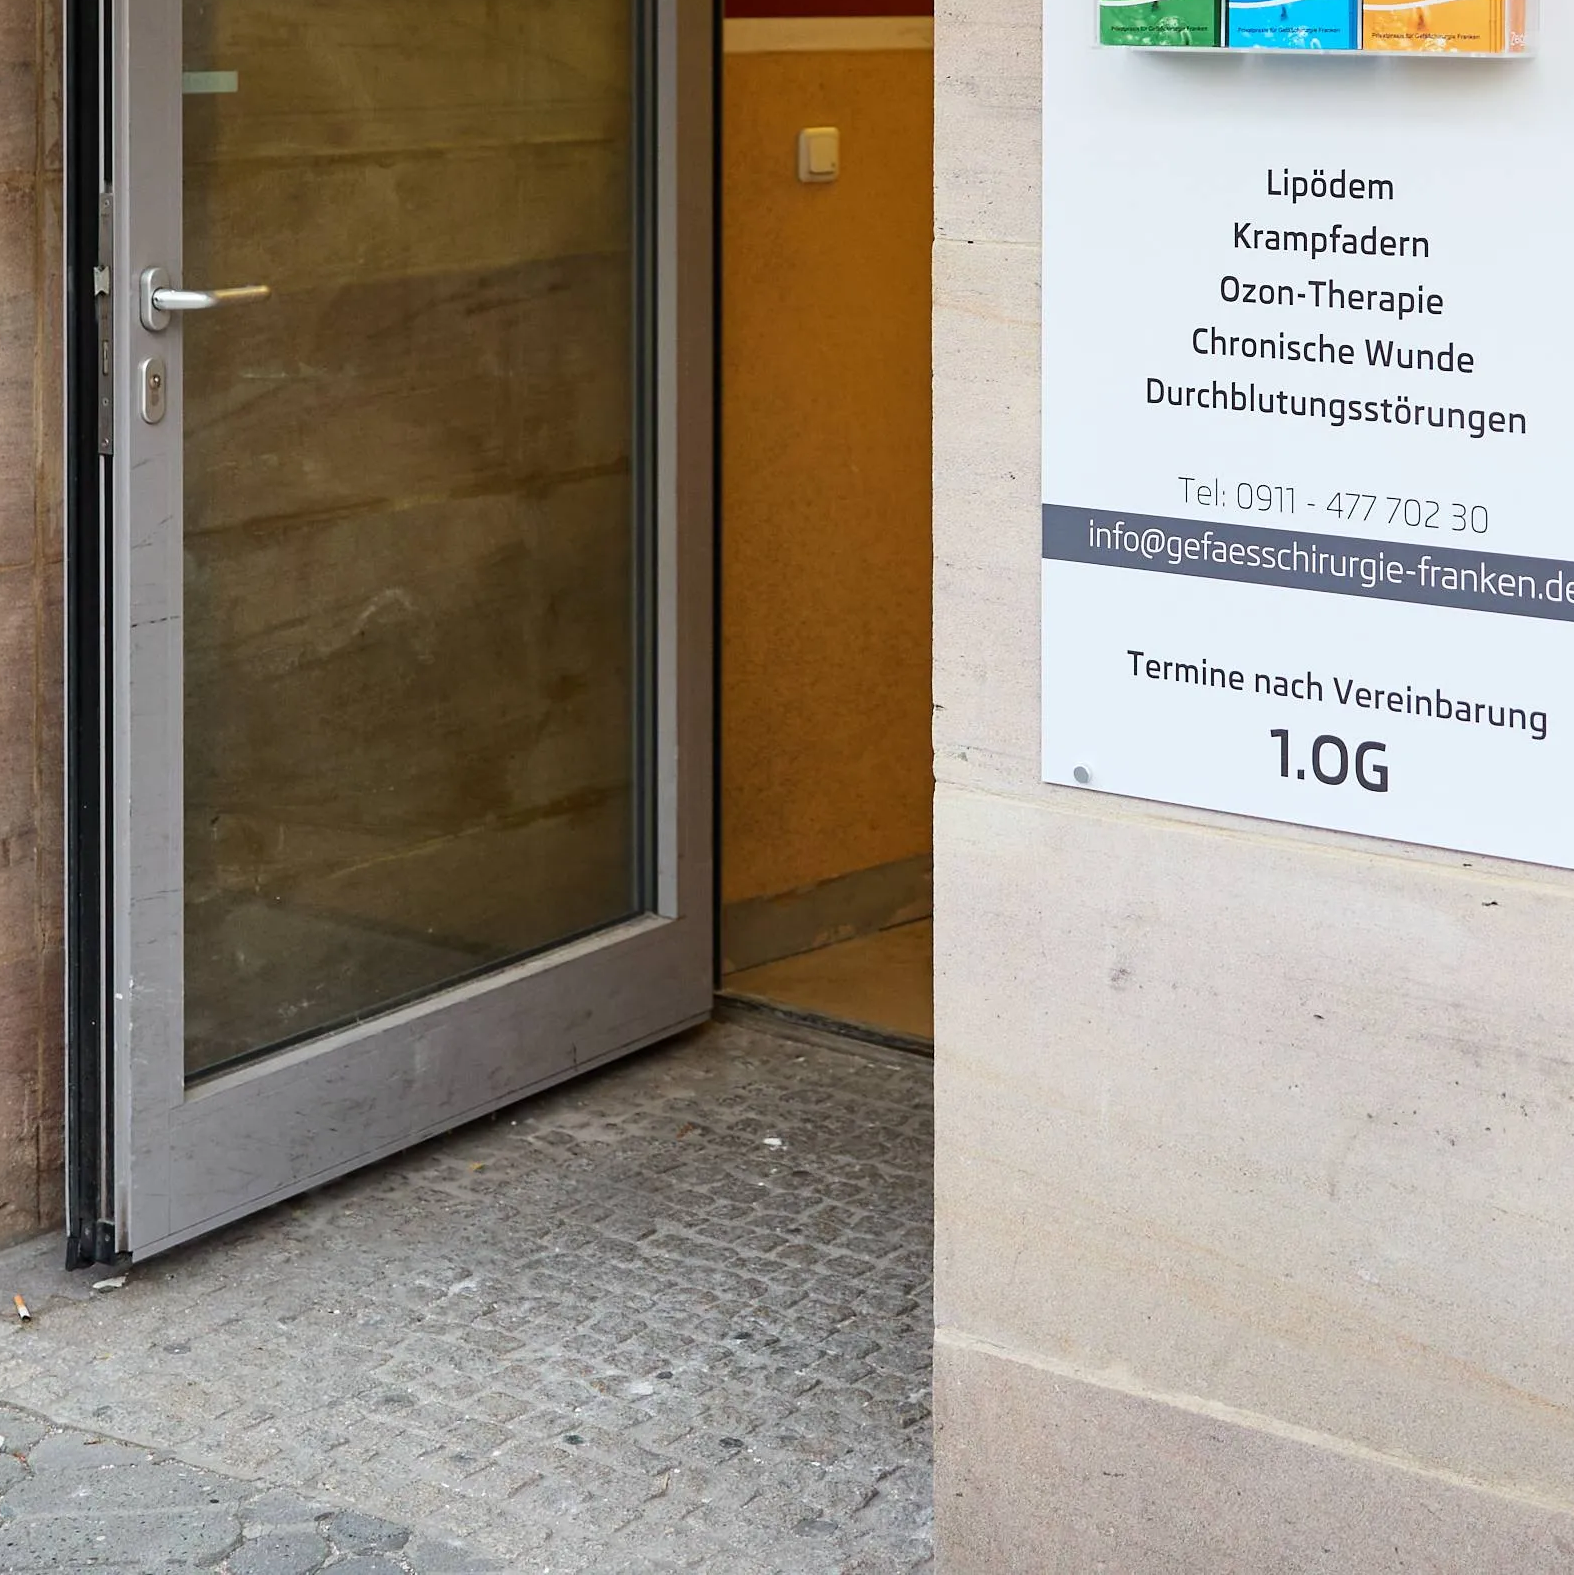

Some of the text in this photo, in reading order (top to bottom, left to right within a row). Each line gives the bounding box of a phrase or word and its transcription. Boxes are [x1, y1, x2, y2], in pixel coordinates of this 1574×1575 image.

[1267, 169, 1394, 203] Lipödem
[1234, 223, 1429, 259] Krampfadern
[1221, 276, 1444, 319] Ozon-Therapie
[1192, 328, 1474, 374] Chronische Wunde
[1146, 377, 1526, 438] Durchblutungsstörungen
[1179, 476, 1226, 508] Tel:
[1236, 482, 1295, 514] 0911
[1326, 492, 1376, 523] 477
[1386, 497, 1441, 529] 702
[1451, 503, 1488, 534] 30
[1127, 649, 1547, 740] Termine nach Vereinbarung
[1271, 728, 1389, 793] 1.OG
